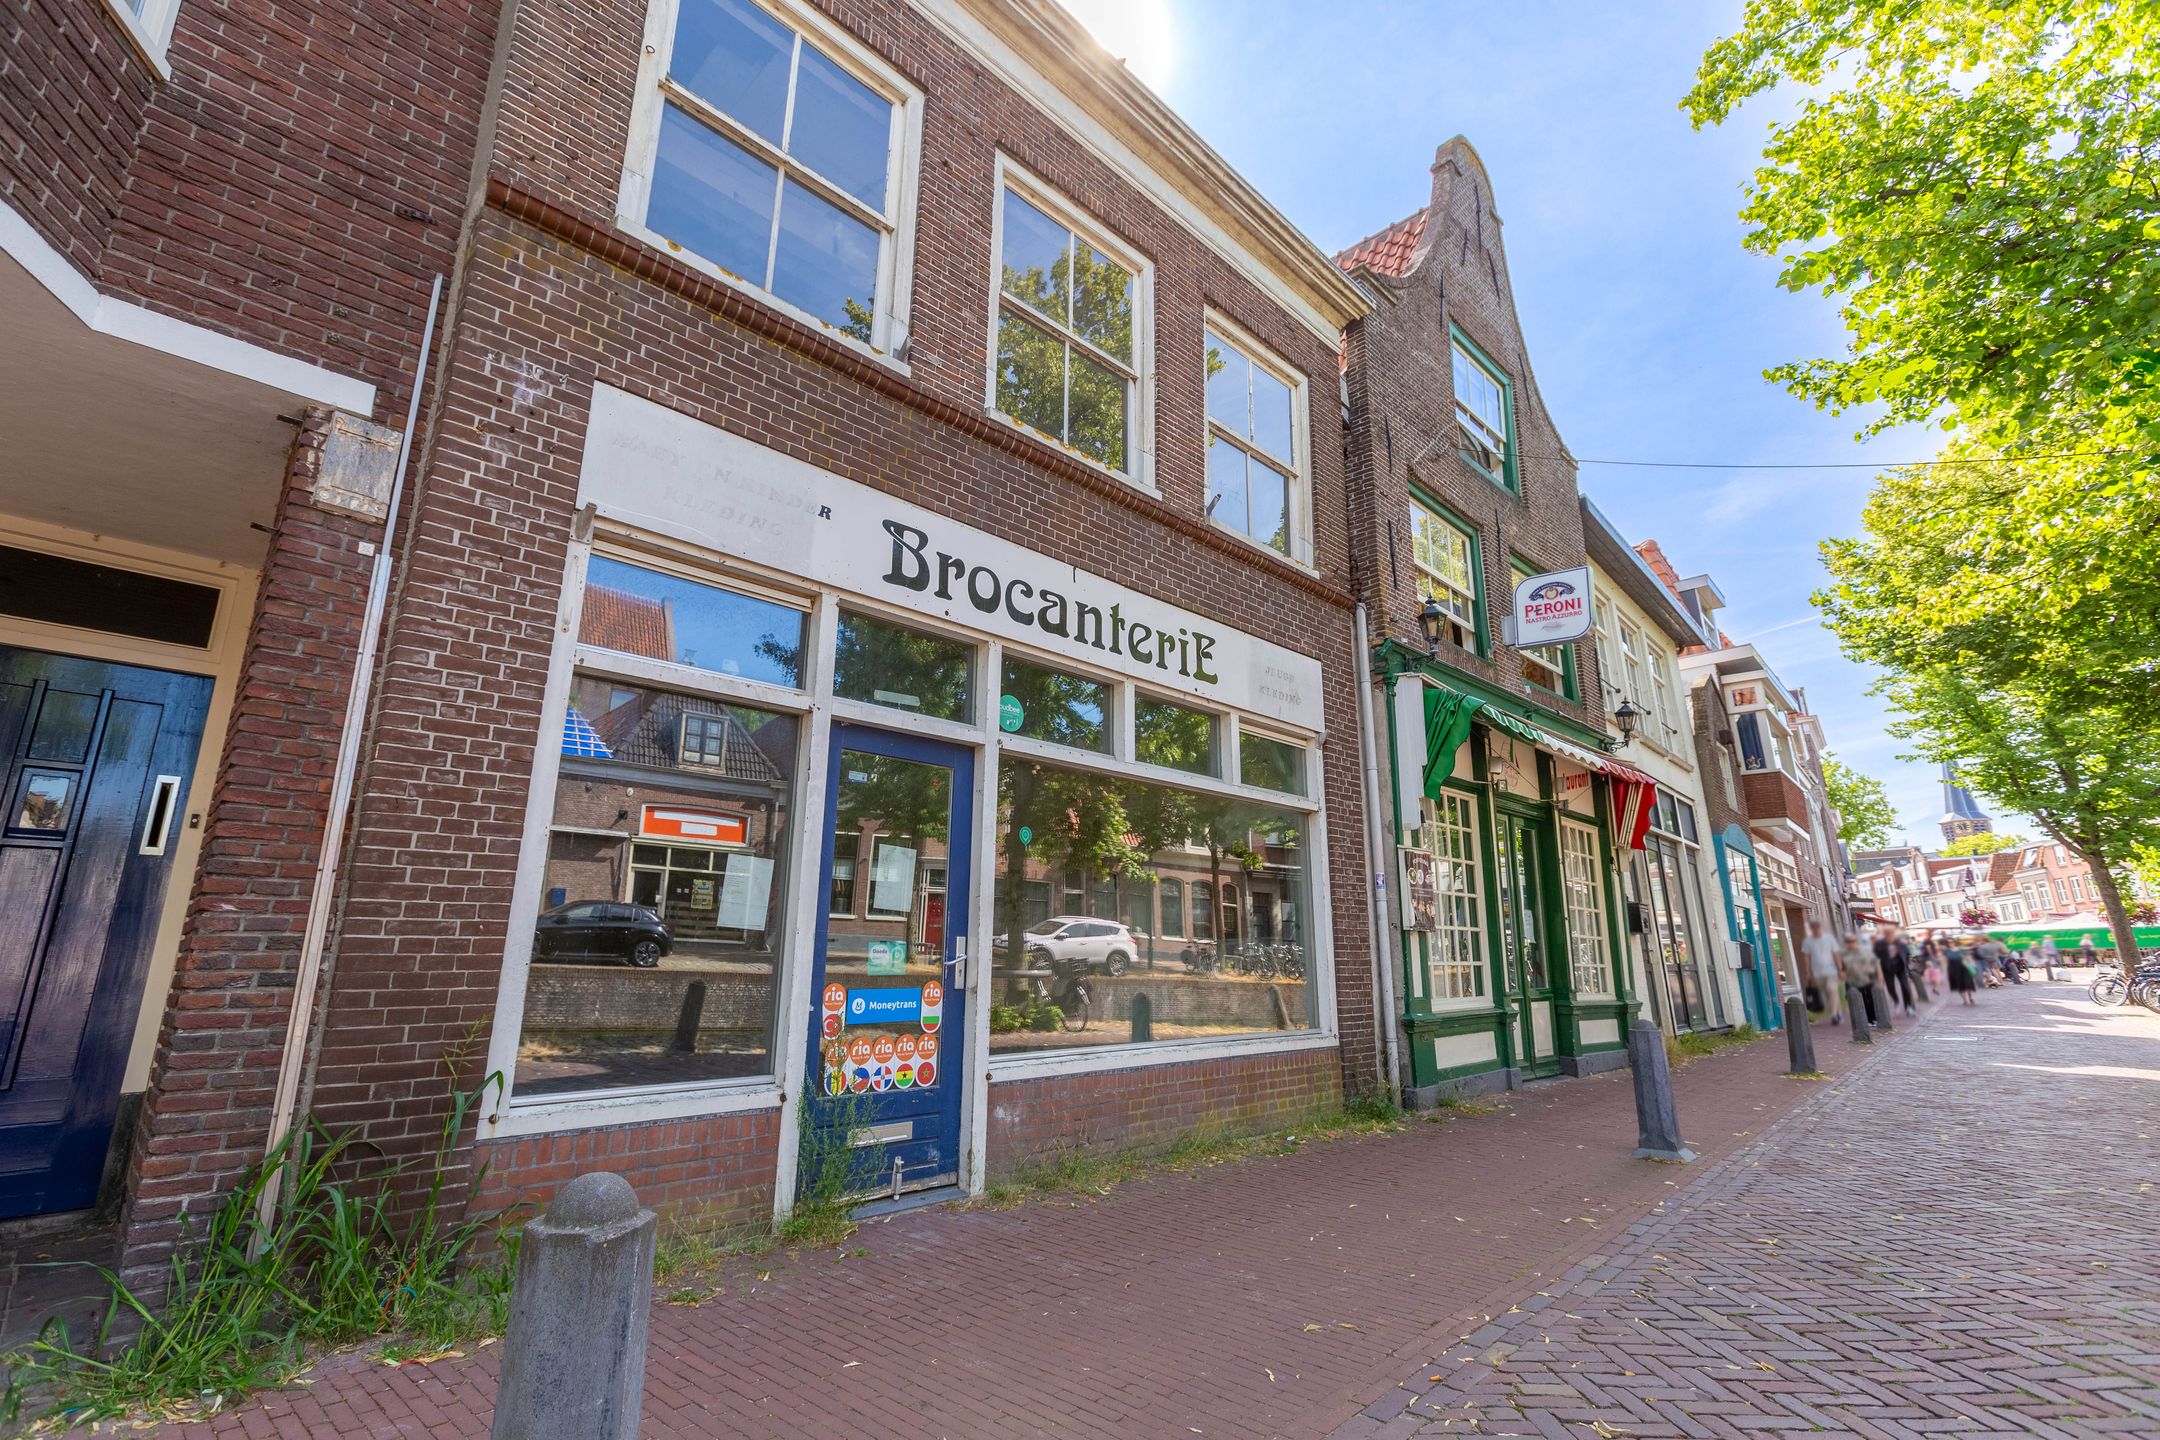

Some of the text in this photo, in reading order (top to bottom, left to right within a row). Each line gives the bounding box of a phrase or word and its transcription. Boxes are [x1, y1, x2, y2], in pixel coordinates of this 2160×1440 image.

[1525, 597, 1582, 618] PERONI
[1525, 610, 1583, 625] NASTRO AZZURRO
[825, 986, 843, 1002] ria
[924, 984, 940, 998] ria
[869, 1001, 917, 1011] Moneytrans
[852, 1040, 871, 1055] ria
[875, 1040, 893, 1054] ria
[897, 1037, 914, 1052] ria
[918, 1036, 935, 1050] ria
